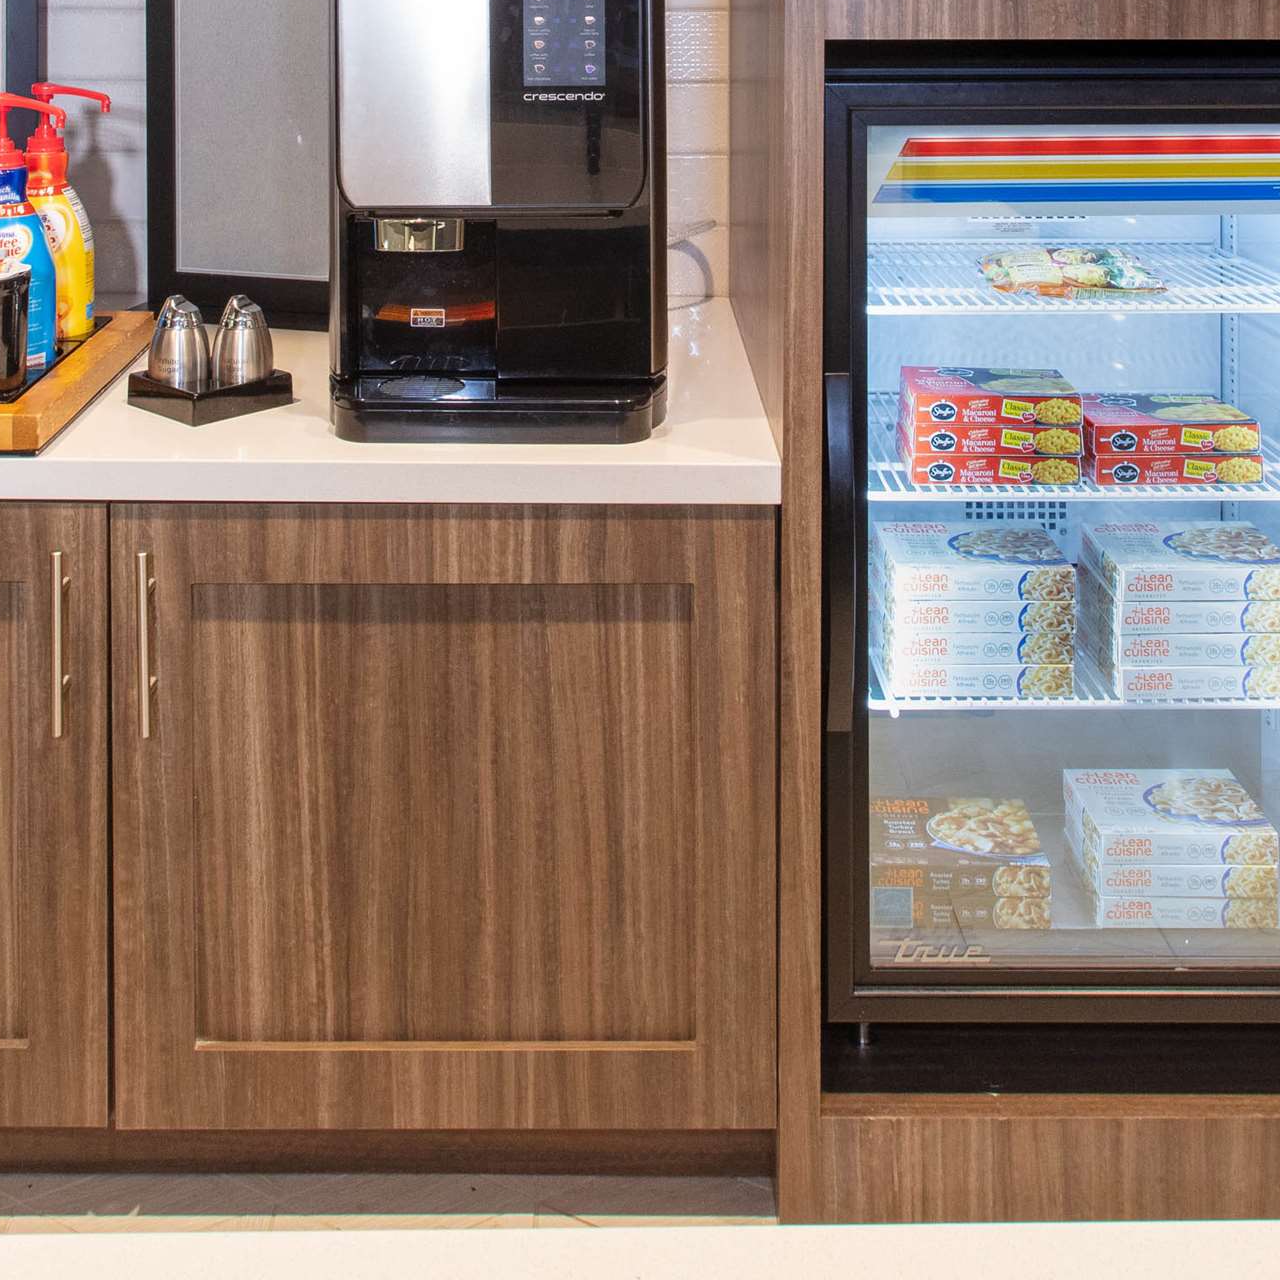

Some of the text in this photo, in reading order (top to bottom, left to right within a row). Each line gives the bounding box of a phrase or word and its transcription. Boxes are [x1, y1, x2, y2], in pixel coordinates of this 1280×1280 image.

[523, 91, 606, 101] crescendo
[1143, 574, 1173, 583] Lean
[1127, 582, 1174, 592] cuisine
[1141, 606, 1170, 616] Lean
[1124, 615, 1170, 625] cuisine
[1140, 639, 1170, 648] Lean
[1124, 647, 1170, 657] cuisine
[1143, 672, 1173, 681] Lean
[1127, 680, 1174, 691] cuisine
[1122, 838, 1152, 847] Lean
[1106, 846, 1152, 857] cuisine
[1122, 869, 1152, 878] Lean
[1106, 877, 1152, 888] cuisine
[1122, 901, 1152, 910] Lean
[1106, 909, 1152, 920] cuisine
